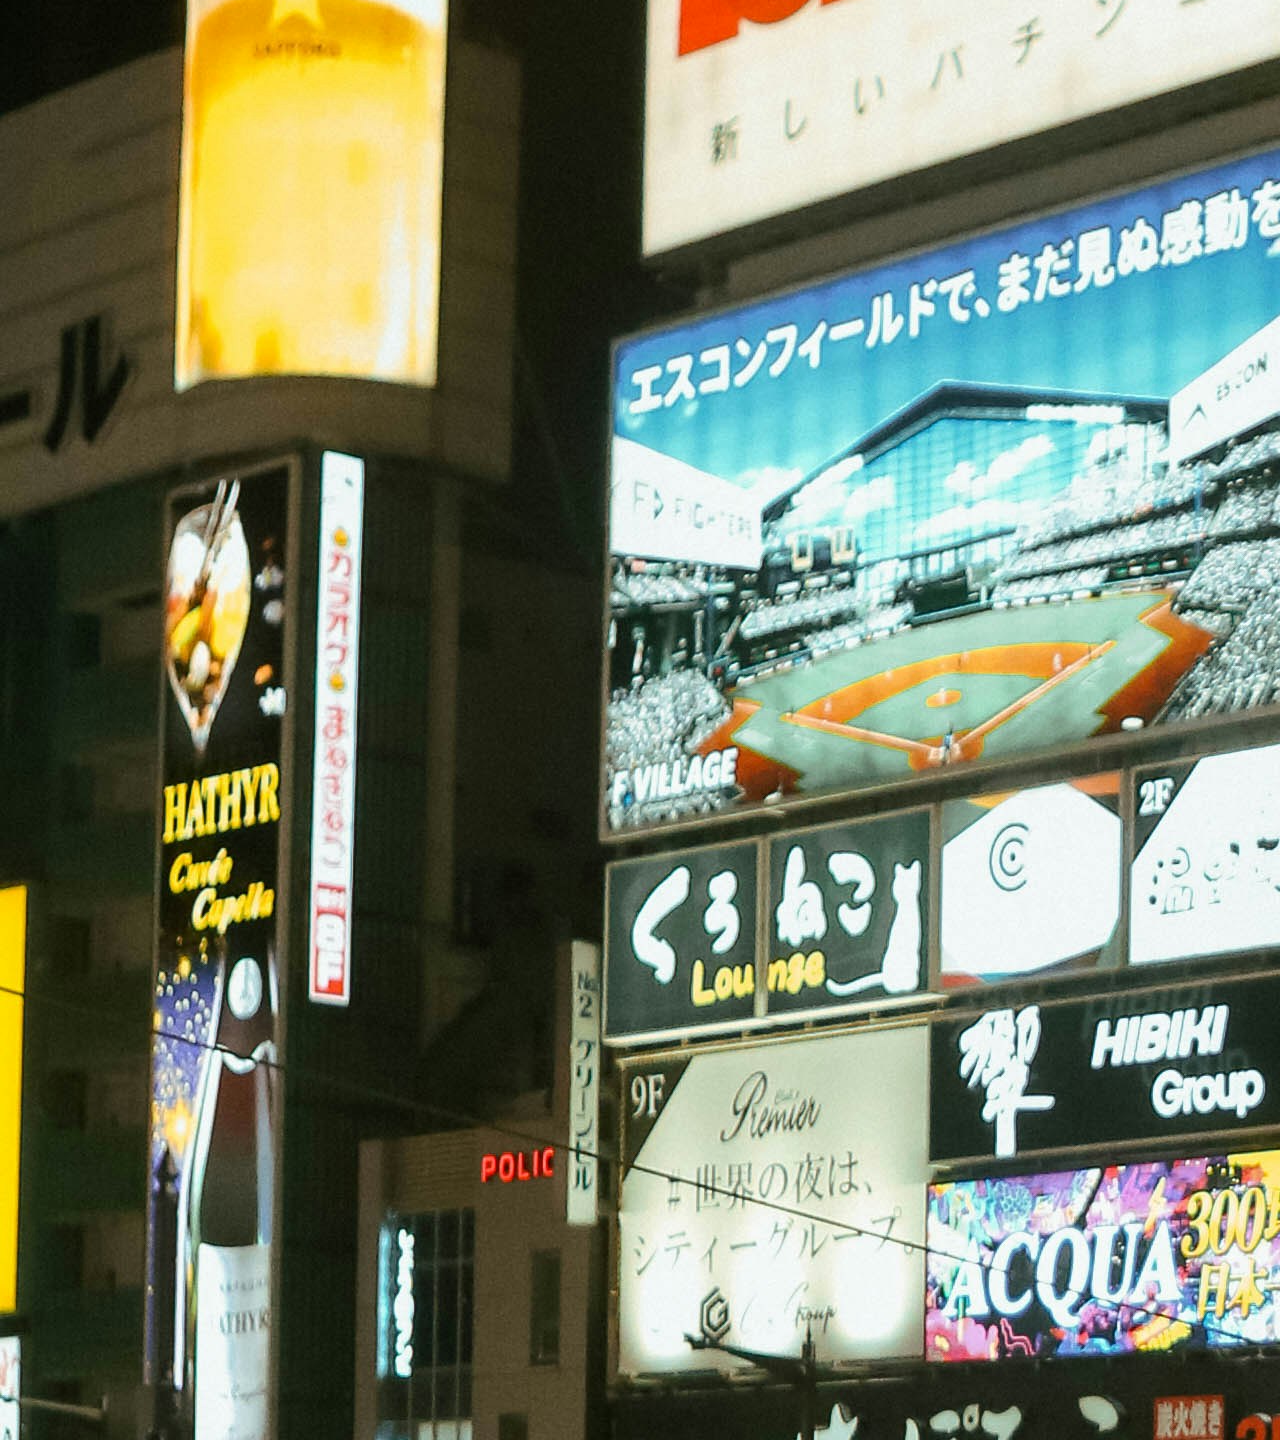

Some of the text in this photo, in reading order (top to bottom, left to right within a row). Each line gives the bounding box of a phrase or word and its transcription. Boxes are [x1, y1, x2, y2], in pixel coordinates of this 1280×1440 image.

[162, 762, 281, 845] HATHYR
[633, 747, 737, 800] VILLAGE
[1139, 777, 1176, 816] 2F
[632, 847, 874, 984] くろねこ
[1091, 1005, 1230, 1069] HIBIKI
[630, 1073, 665, 1118] 9F
[720, 1071, 821, 1142] Premier
[1151, 1068, 1266, 1120] Group
[943, 1218, 1185, 1333] ACQUA
